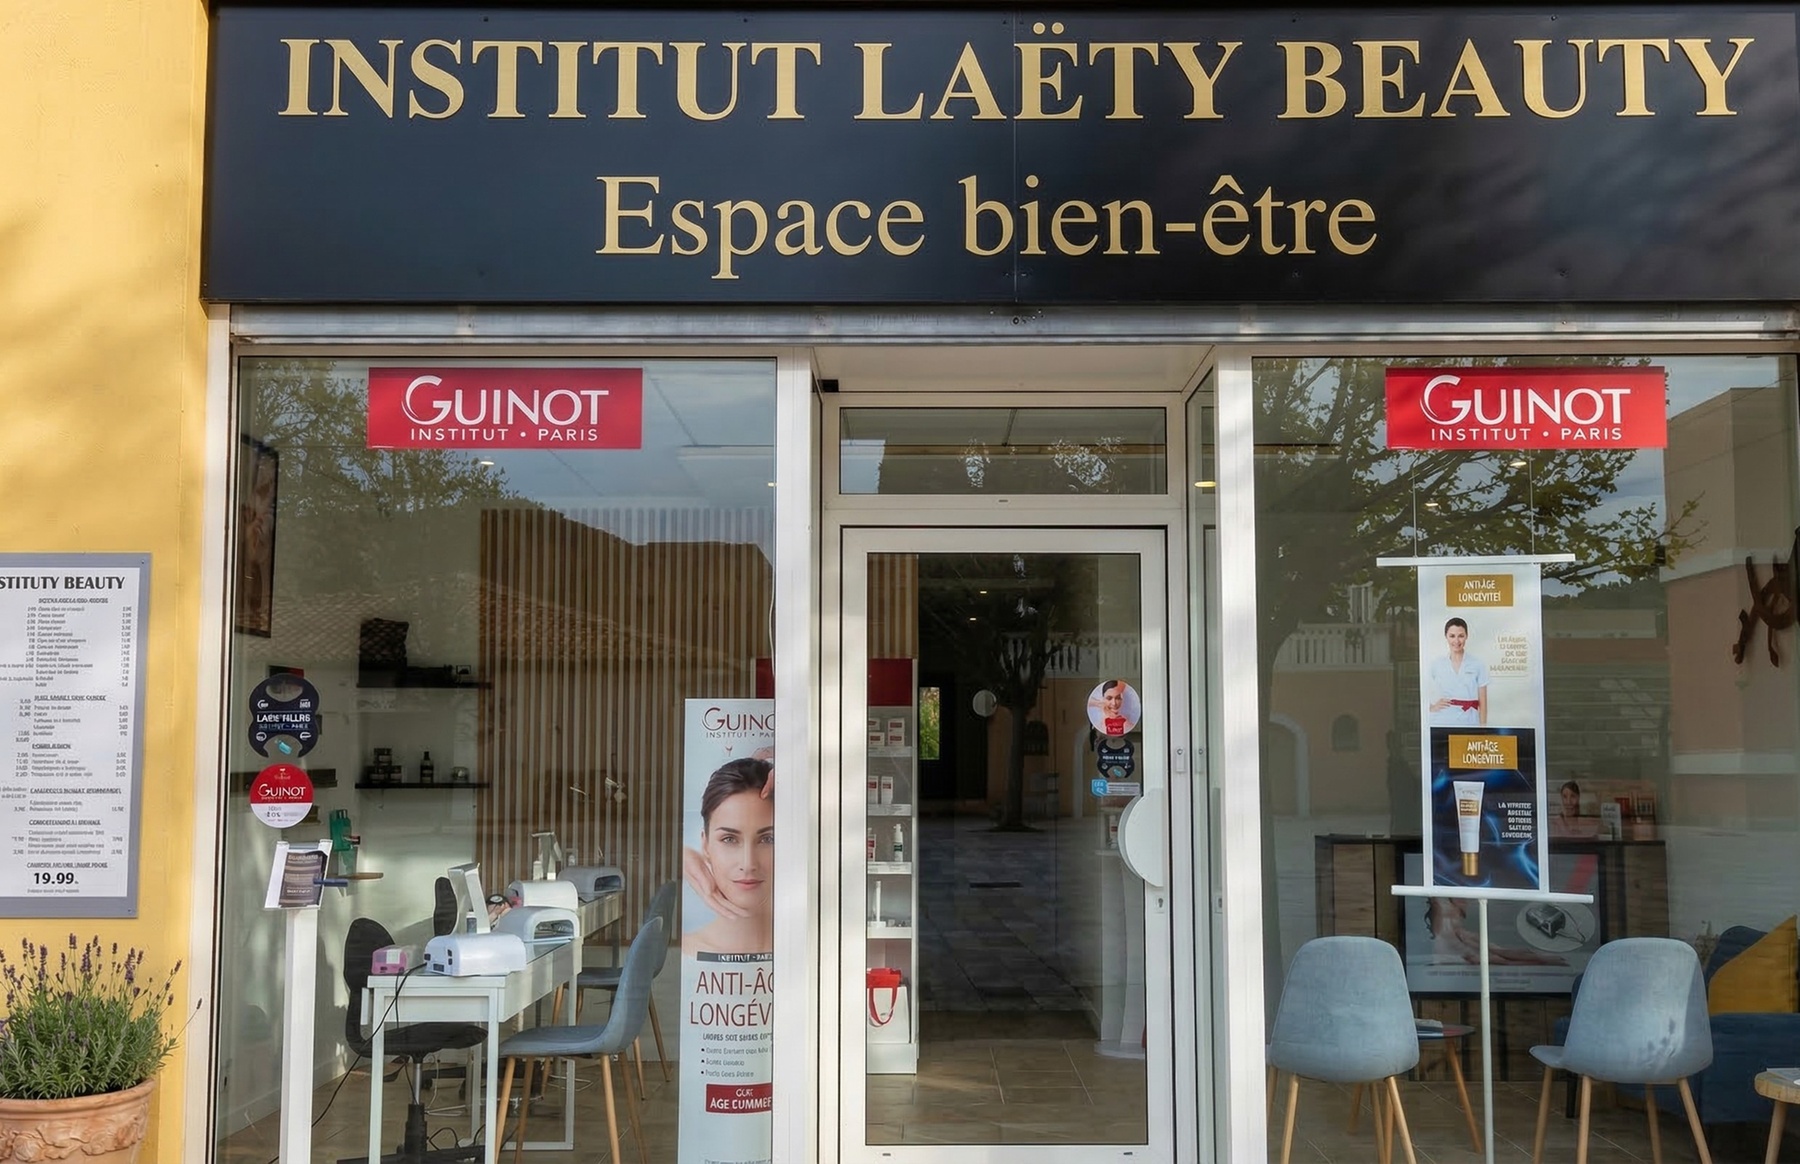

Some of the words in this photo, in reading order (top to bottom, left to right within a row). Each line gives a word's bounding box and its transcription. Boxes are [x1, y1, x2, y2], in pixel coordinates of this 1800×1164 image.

[279, 38, 822, 121] INSTITUT
[853, 22, 1243, 120] LAËTY
[1276, 38, 1755, 119] BEAUTY
[596, 175, 925, 280] Espace
[958, 174, 1378, 256] bien-être
[401, 374, 610, 426] GUINOT
[1419, 374, 1631, 425] GUINOT
[411, 428, 509, 441] INSTITUT
[538, 428, 598, 441] PARIS
[1431, 428, 1531, 441] INSTITUT
[1561, 427, 1622, 441] PARIS
[64, 576, 125, 590] BEAUTY
[258, 783, 307, 797] GUINOT
[710, 1098, 730, 1109] AGE
